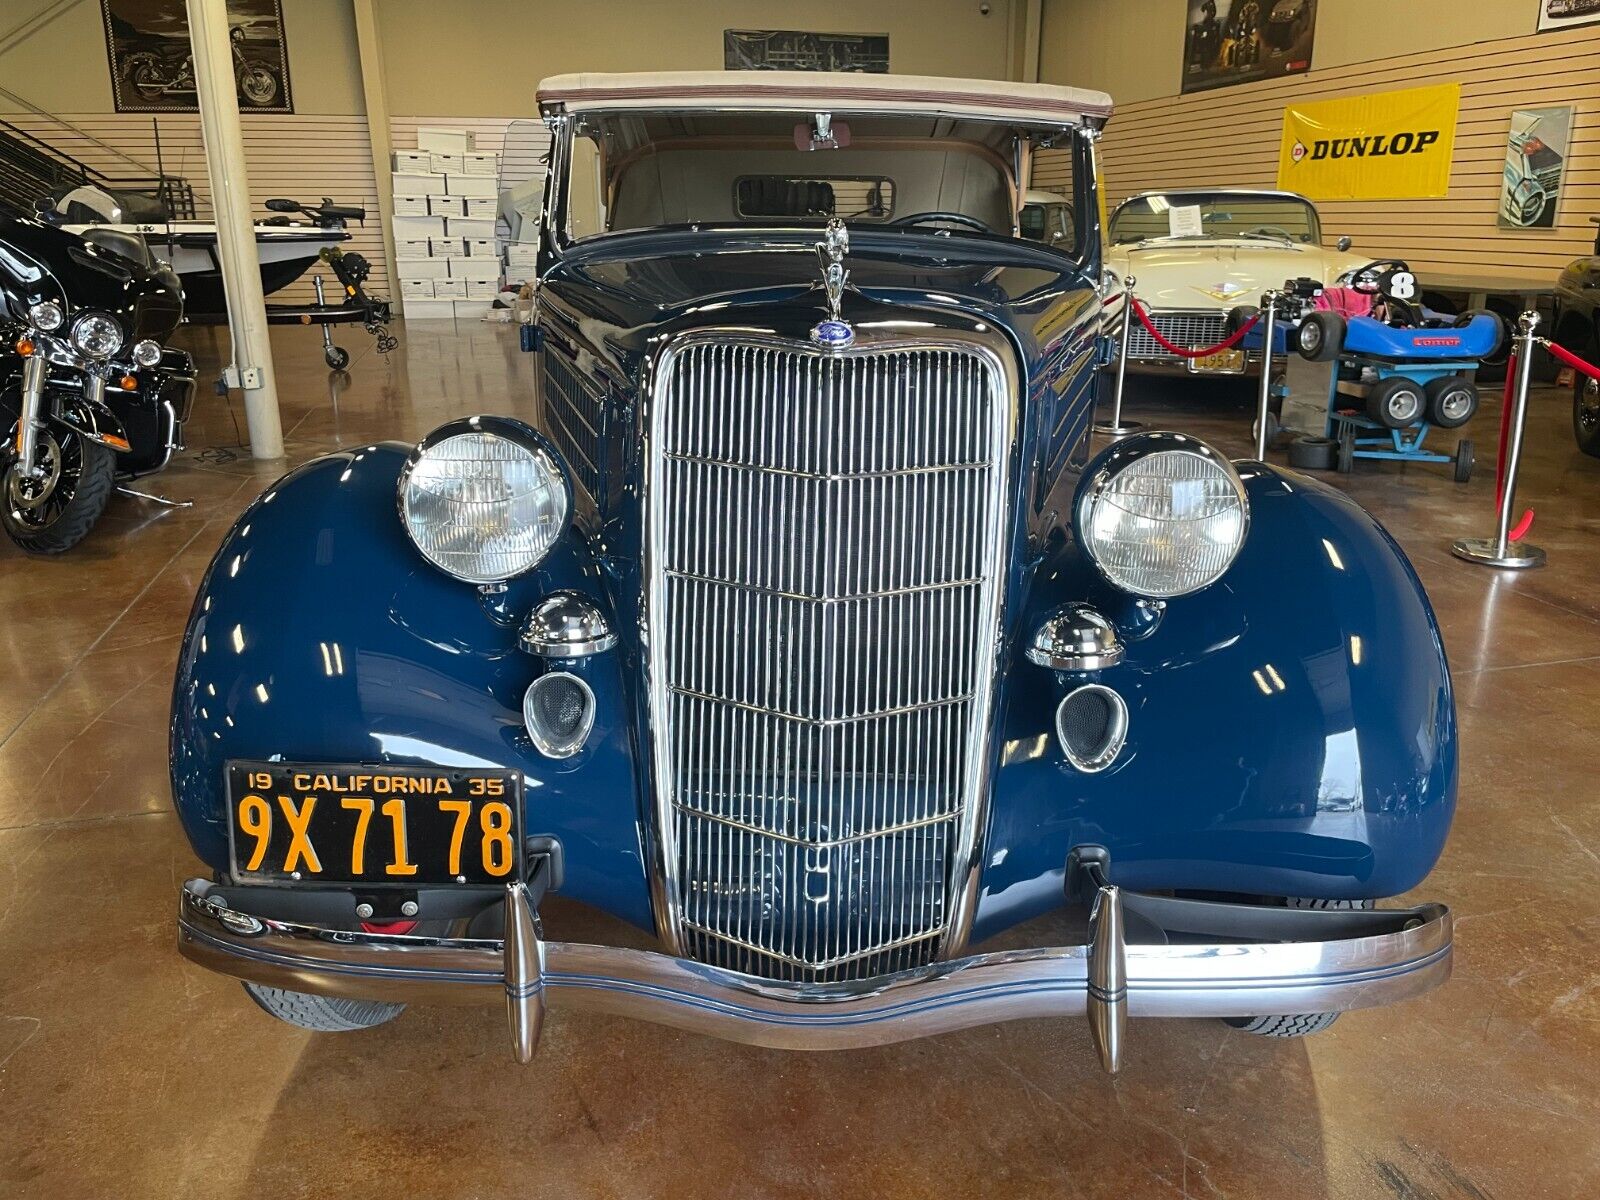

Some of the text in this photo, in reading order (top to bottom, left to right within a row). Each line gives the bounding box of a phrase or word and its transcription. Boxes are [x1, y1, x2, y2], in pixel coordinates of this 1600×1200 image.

[1295, 131, 1440, 160] D DUNLOP
[1390, 272, 1415, 299] 8
[819, 324, 847, 337] Ford
[249, 773, 505, 796] 19 CALIFORNIA 35
[238, 795, 514, 877] 9X 71 78
